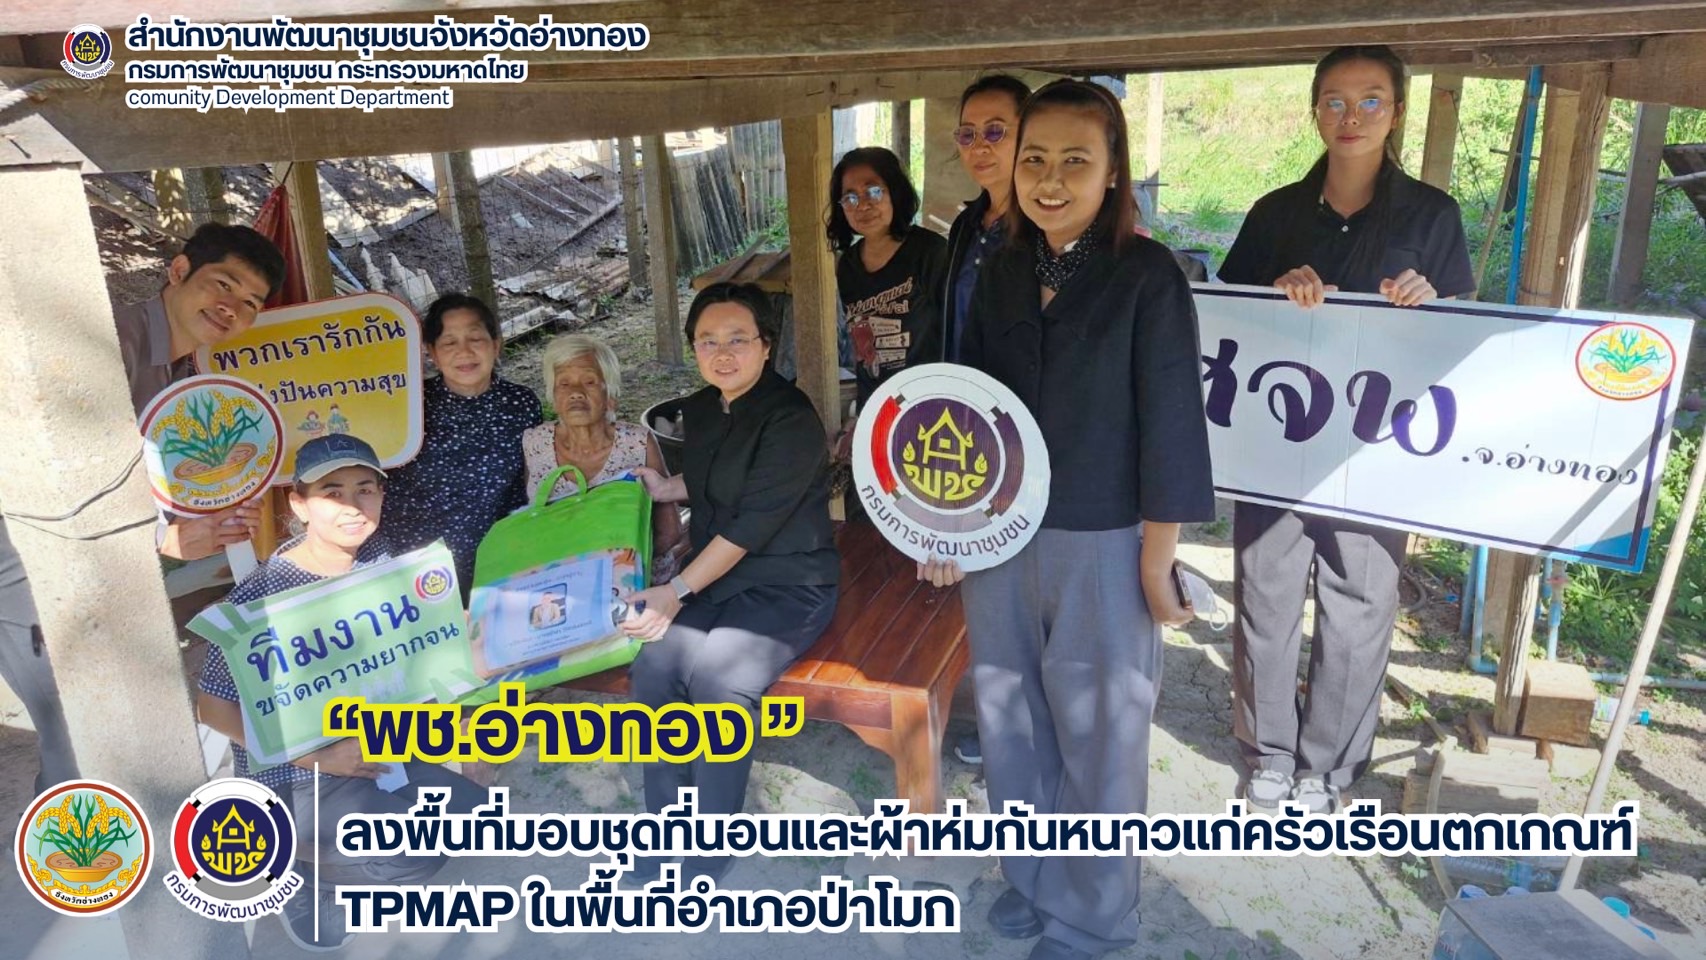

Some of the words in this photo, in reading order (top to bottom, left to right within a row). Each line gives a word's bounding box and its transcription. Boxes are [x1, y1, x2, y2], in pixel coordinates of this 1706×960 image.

[212, 315, 407, 372] พวกเรารักกัน
[258, 372, 407, 404] ่งปันความสุข
[861, 484, 1031, 557] กรมการพัฒนาชุมชน
[246, 594, 421, 683] ทีมงาน
[255, 621, 460, 717] ขจัดความยากจน
